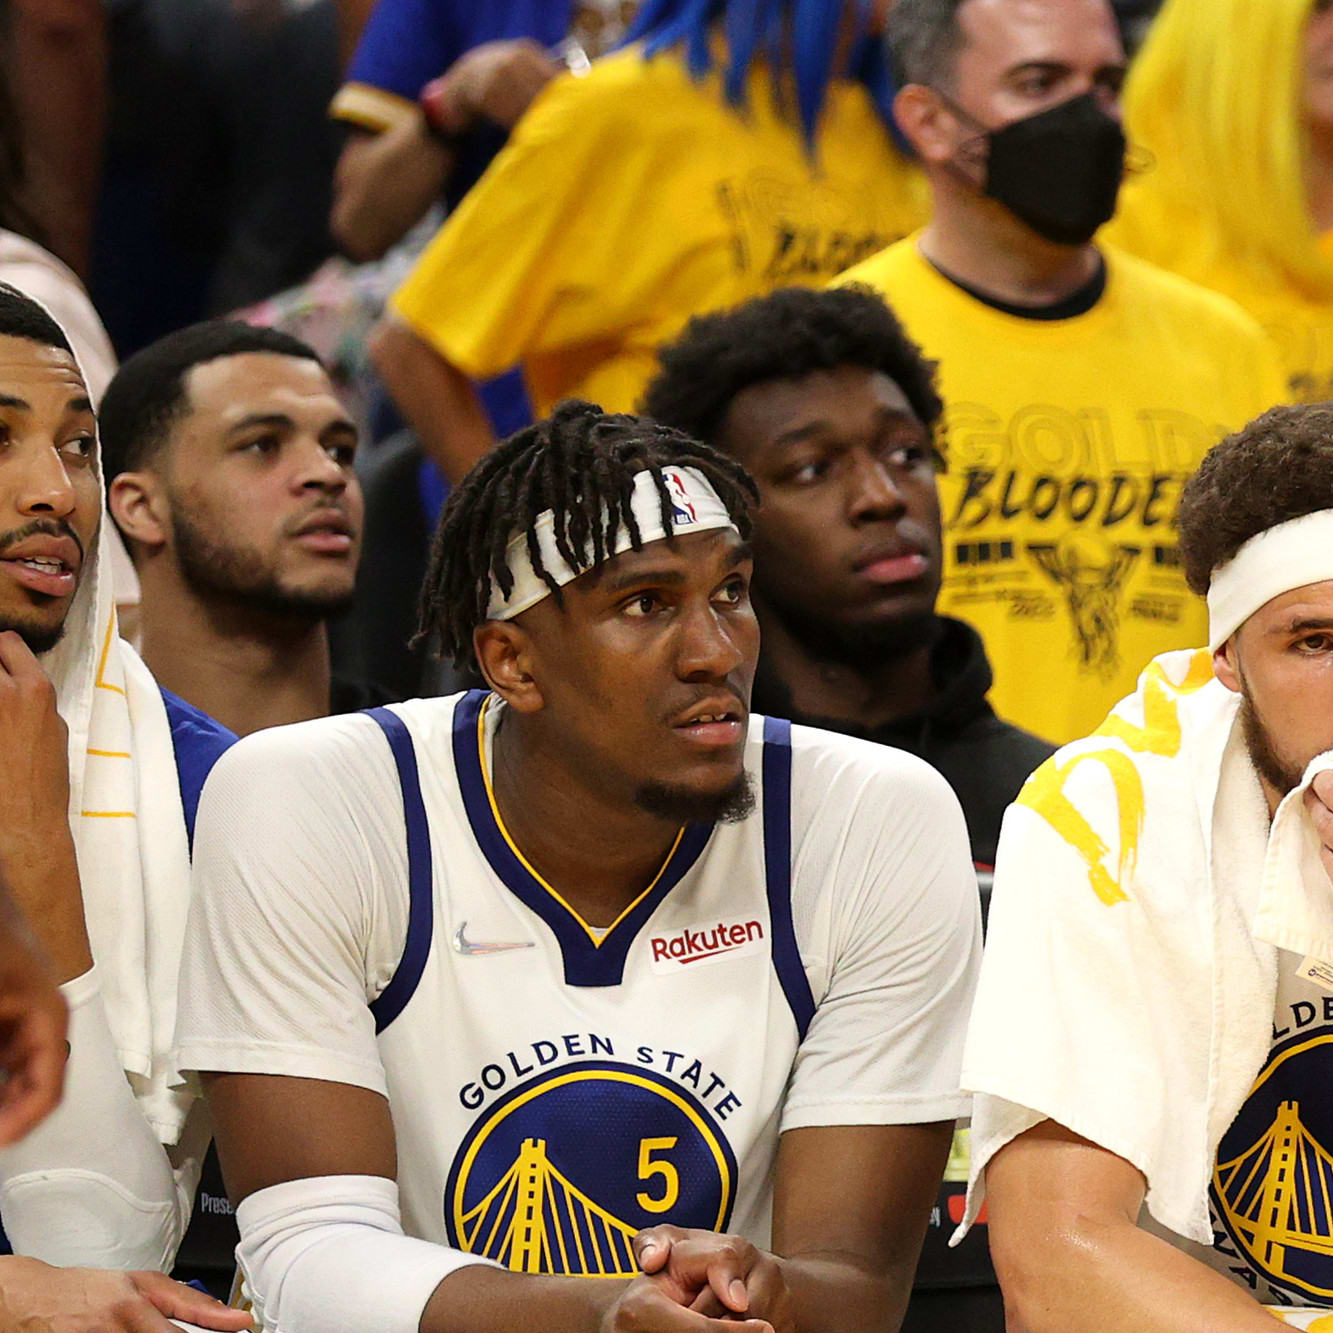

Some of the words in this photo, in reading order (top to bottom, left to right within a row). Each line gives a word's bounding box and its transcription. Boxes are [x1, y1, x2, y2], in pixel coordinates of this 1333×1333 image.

[651, 920, 764, 964] Rakuten
[459, 1033, 615, 1110] GOLDEN
[636, 1046, 743, 1121] STATE
[636, 1136, 679, 1214] 5
